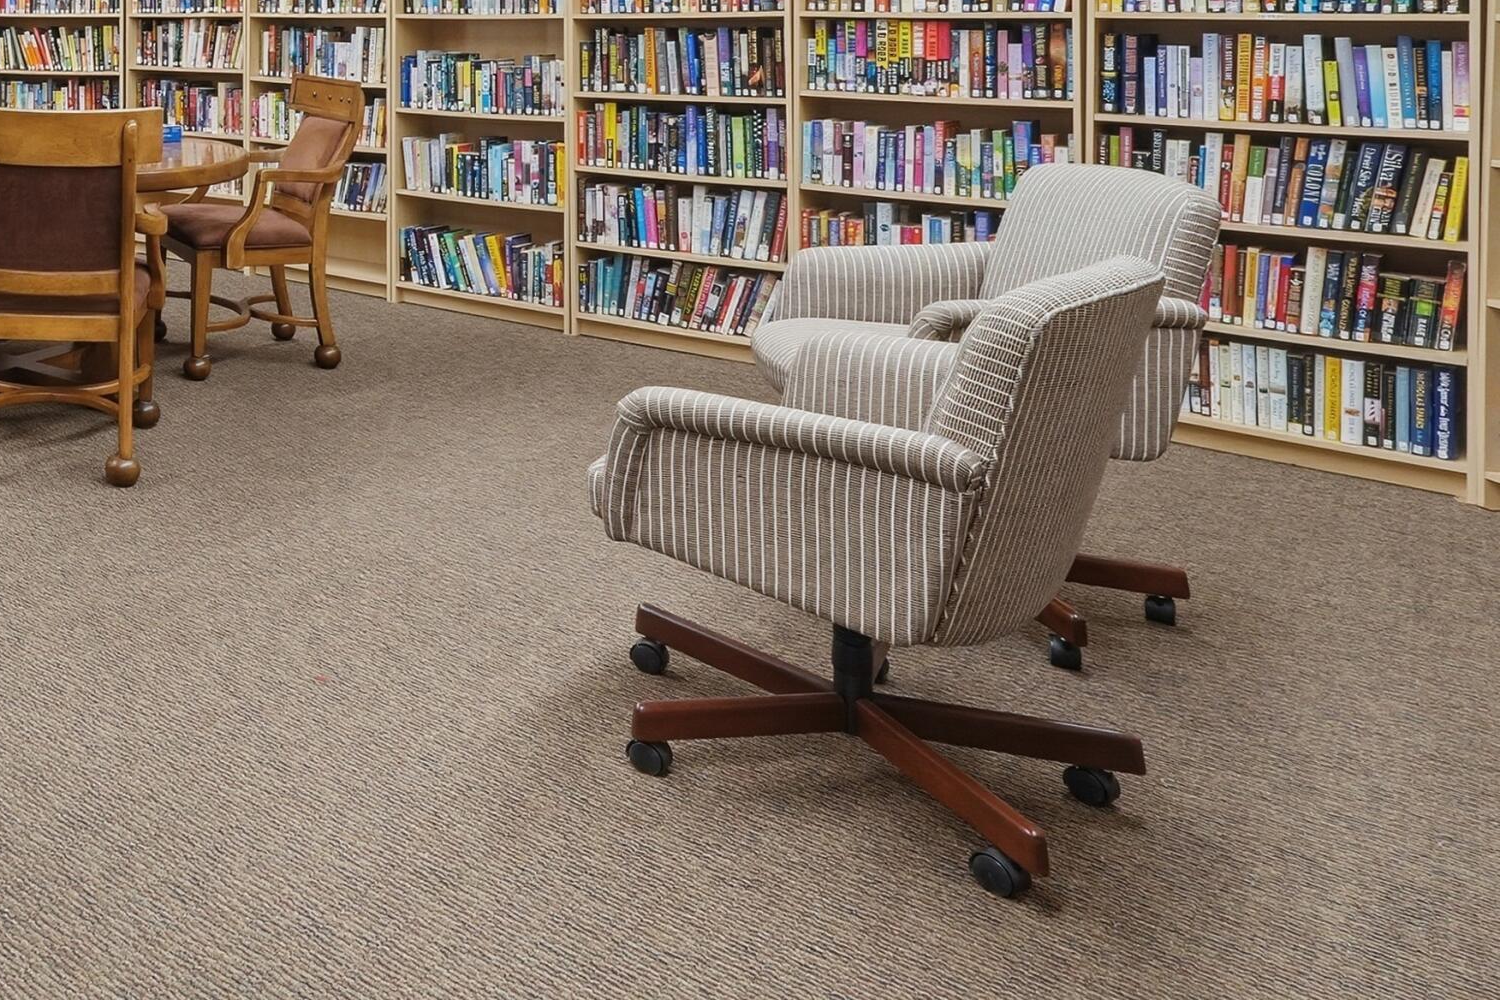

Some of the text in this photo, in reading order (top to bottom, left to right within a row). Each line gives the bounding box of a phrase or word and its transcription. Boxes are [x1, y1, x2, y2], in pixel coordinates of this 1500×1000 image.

[1357, 170, 1373, 188] Silva
[1379, 153, 1404, 181] Silva
[1303, 163, 1324, 204] COLONY
